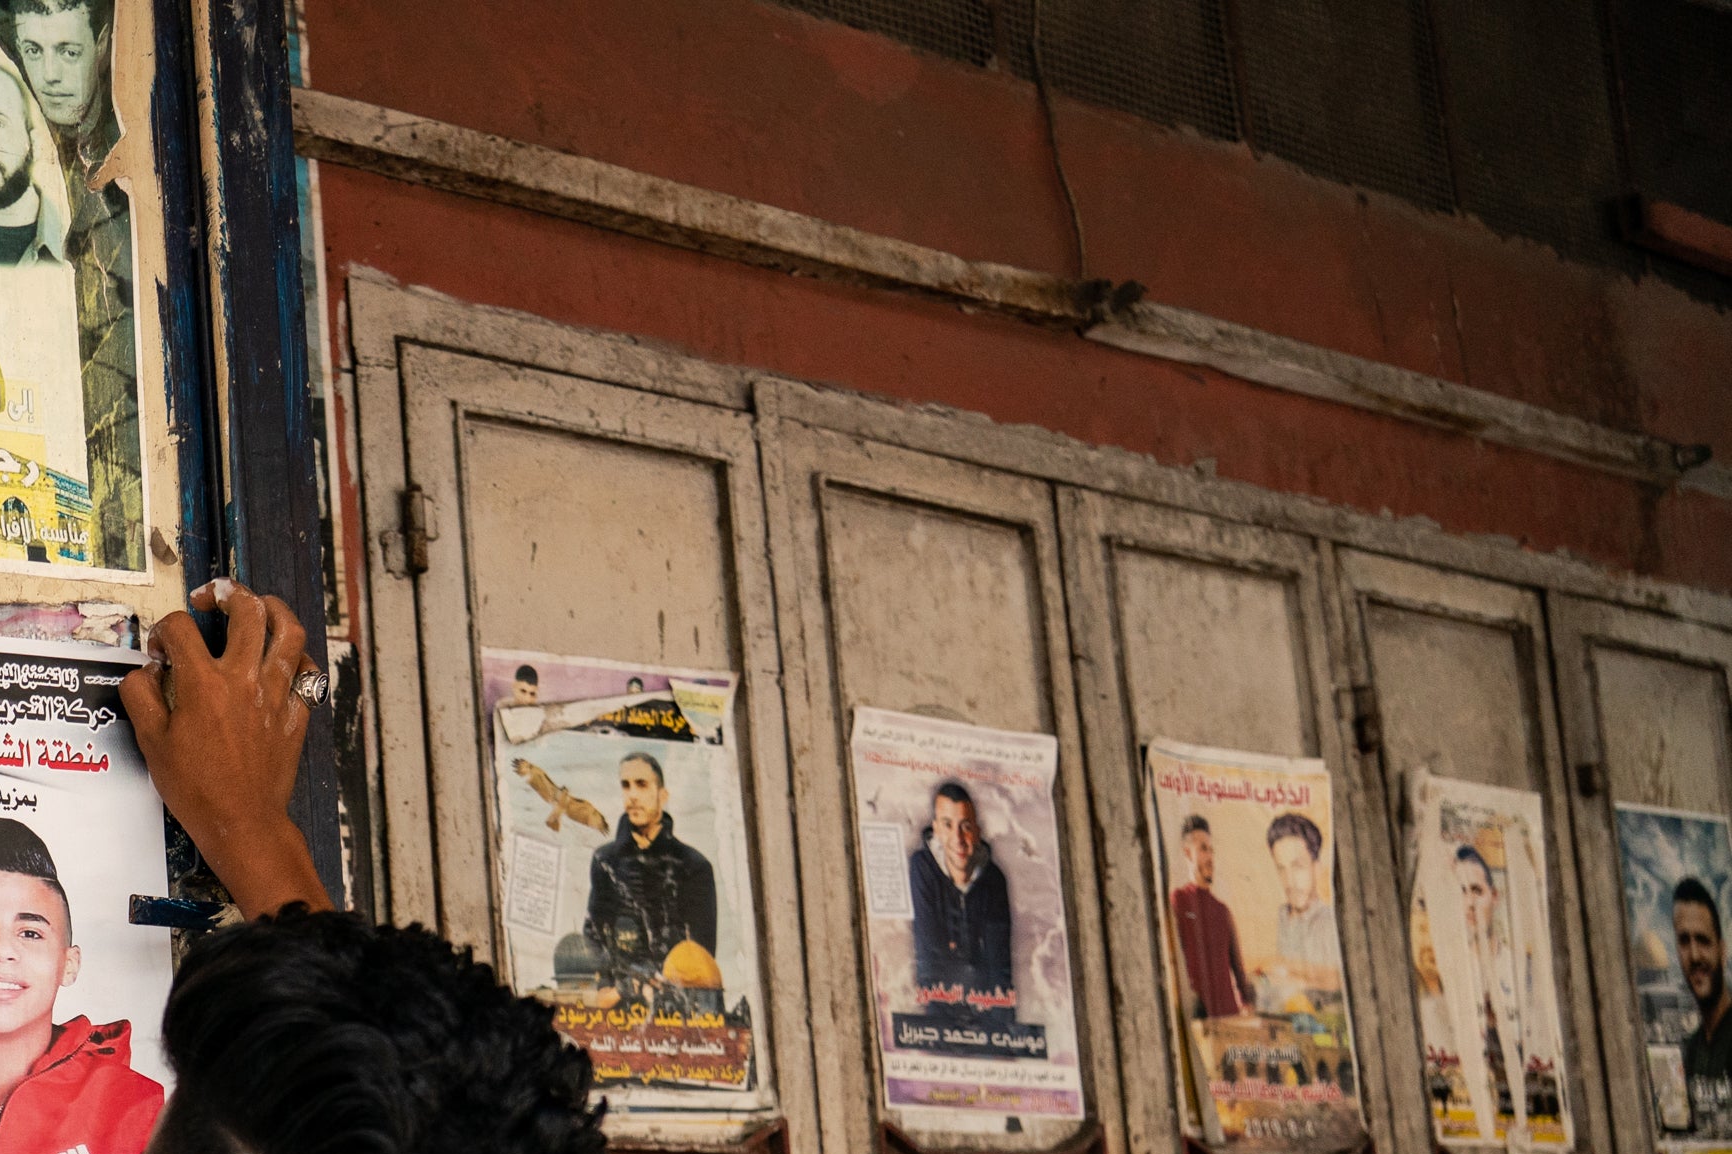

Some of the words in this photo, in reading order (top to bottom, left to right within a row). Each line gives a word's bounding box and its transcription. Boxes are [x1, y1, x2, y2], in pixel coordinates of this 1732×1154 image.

[7, 390, 34, 423] إلى
[56, 699, 115, 731] حركة
[38, 738, 109, 772] منطقة
[654, 1008, 684, 1030] عبد
[898, 1022, 939, 1047] جبريل
[943, 1028, 989, 1046] محمد
[991, 1033, 1047, 1055] موسى
